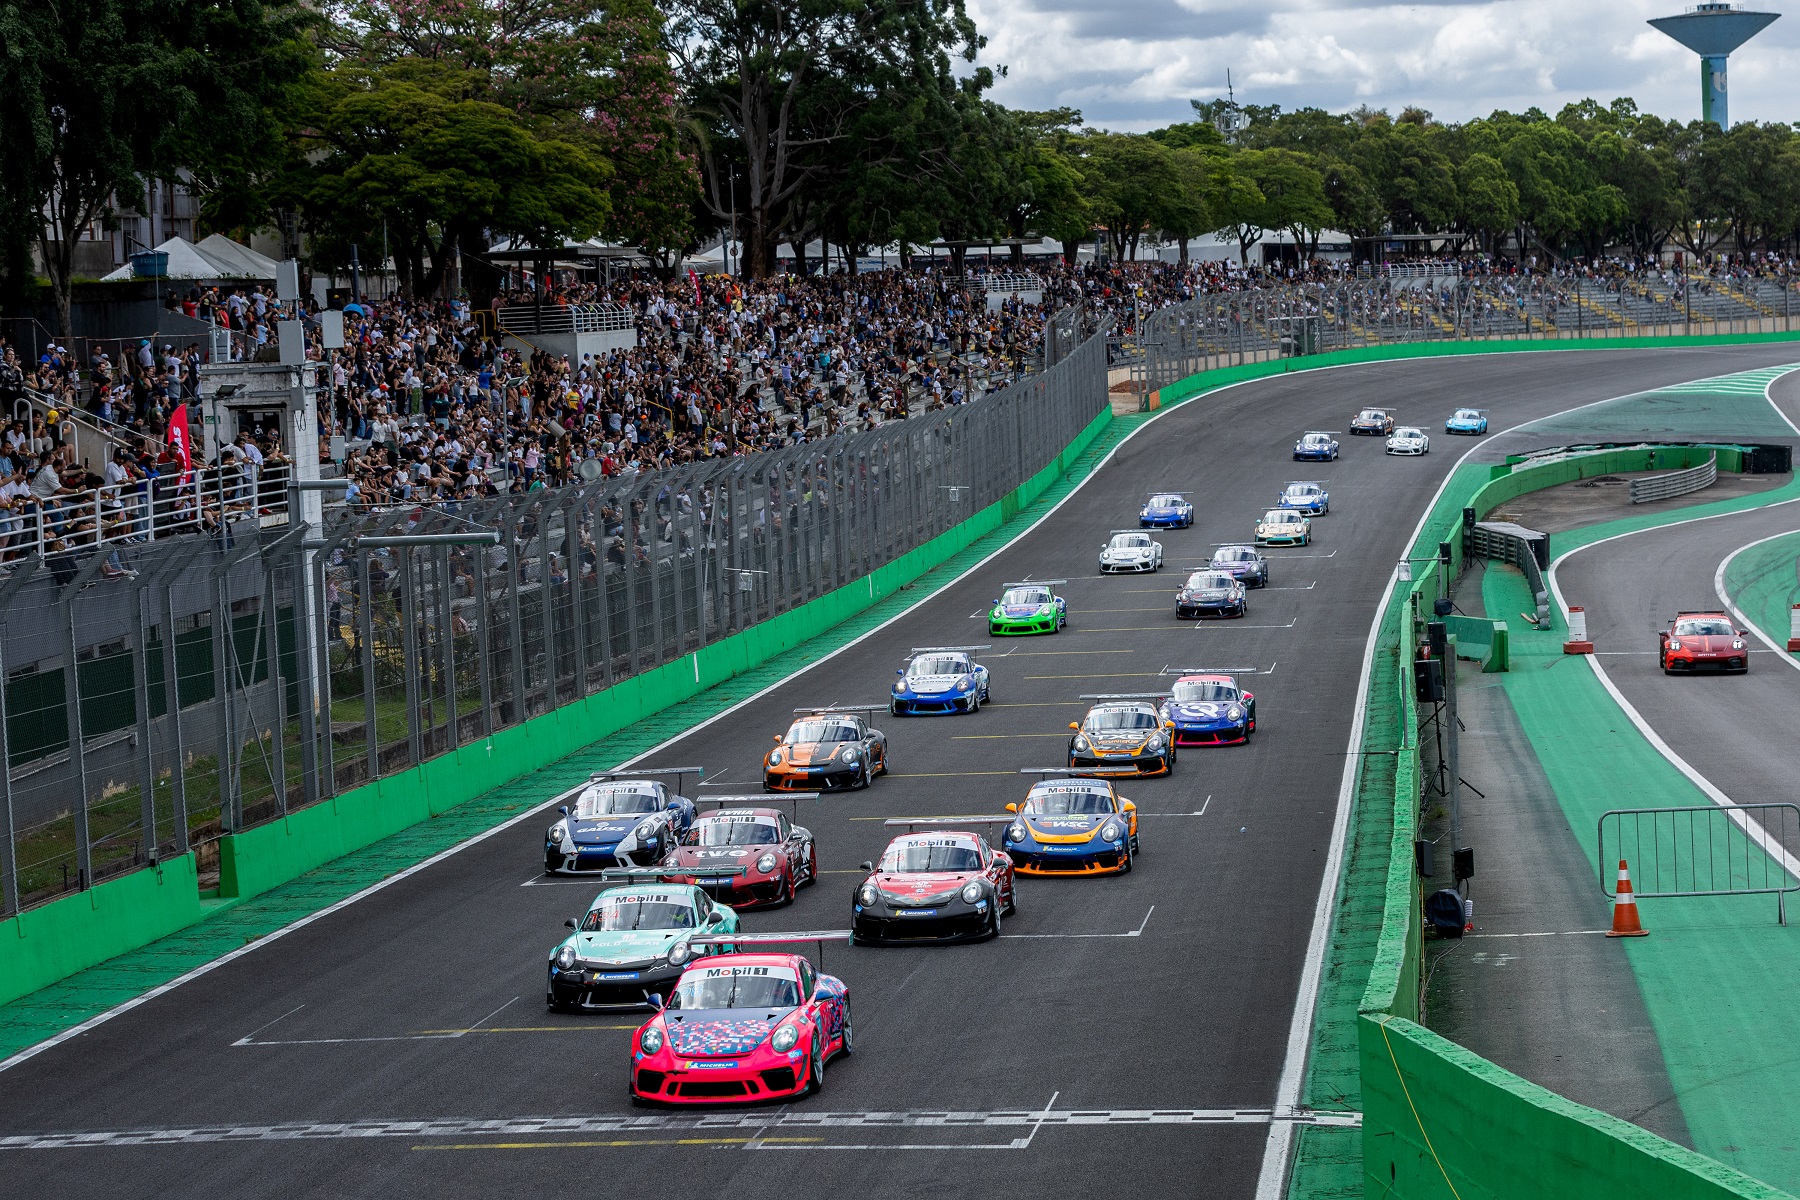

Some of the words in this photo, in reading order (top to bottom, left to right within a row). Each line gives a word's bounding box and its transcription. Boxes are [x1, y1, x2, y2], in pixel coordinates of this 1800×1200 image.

[596, 787, 627, 796] Mobil
[710, 816, 744, 824] Mobil
[576, 826, 626, 834] GAUSS
[907, 839, 943, 848] Mobil
[694, 849, 749, 858] two
[615, 894, 654, 904] Mobil
[591, 940, 621, 948] POLO
[706, 966, 751, 978] Mobil
